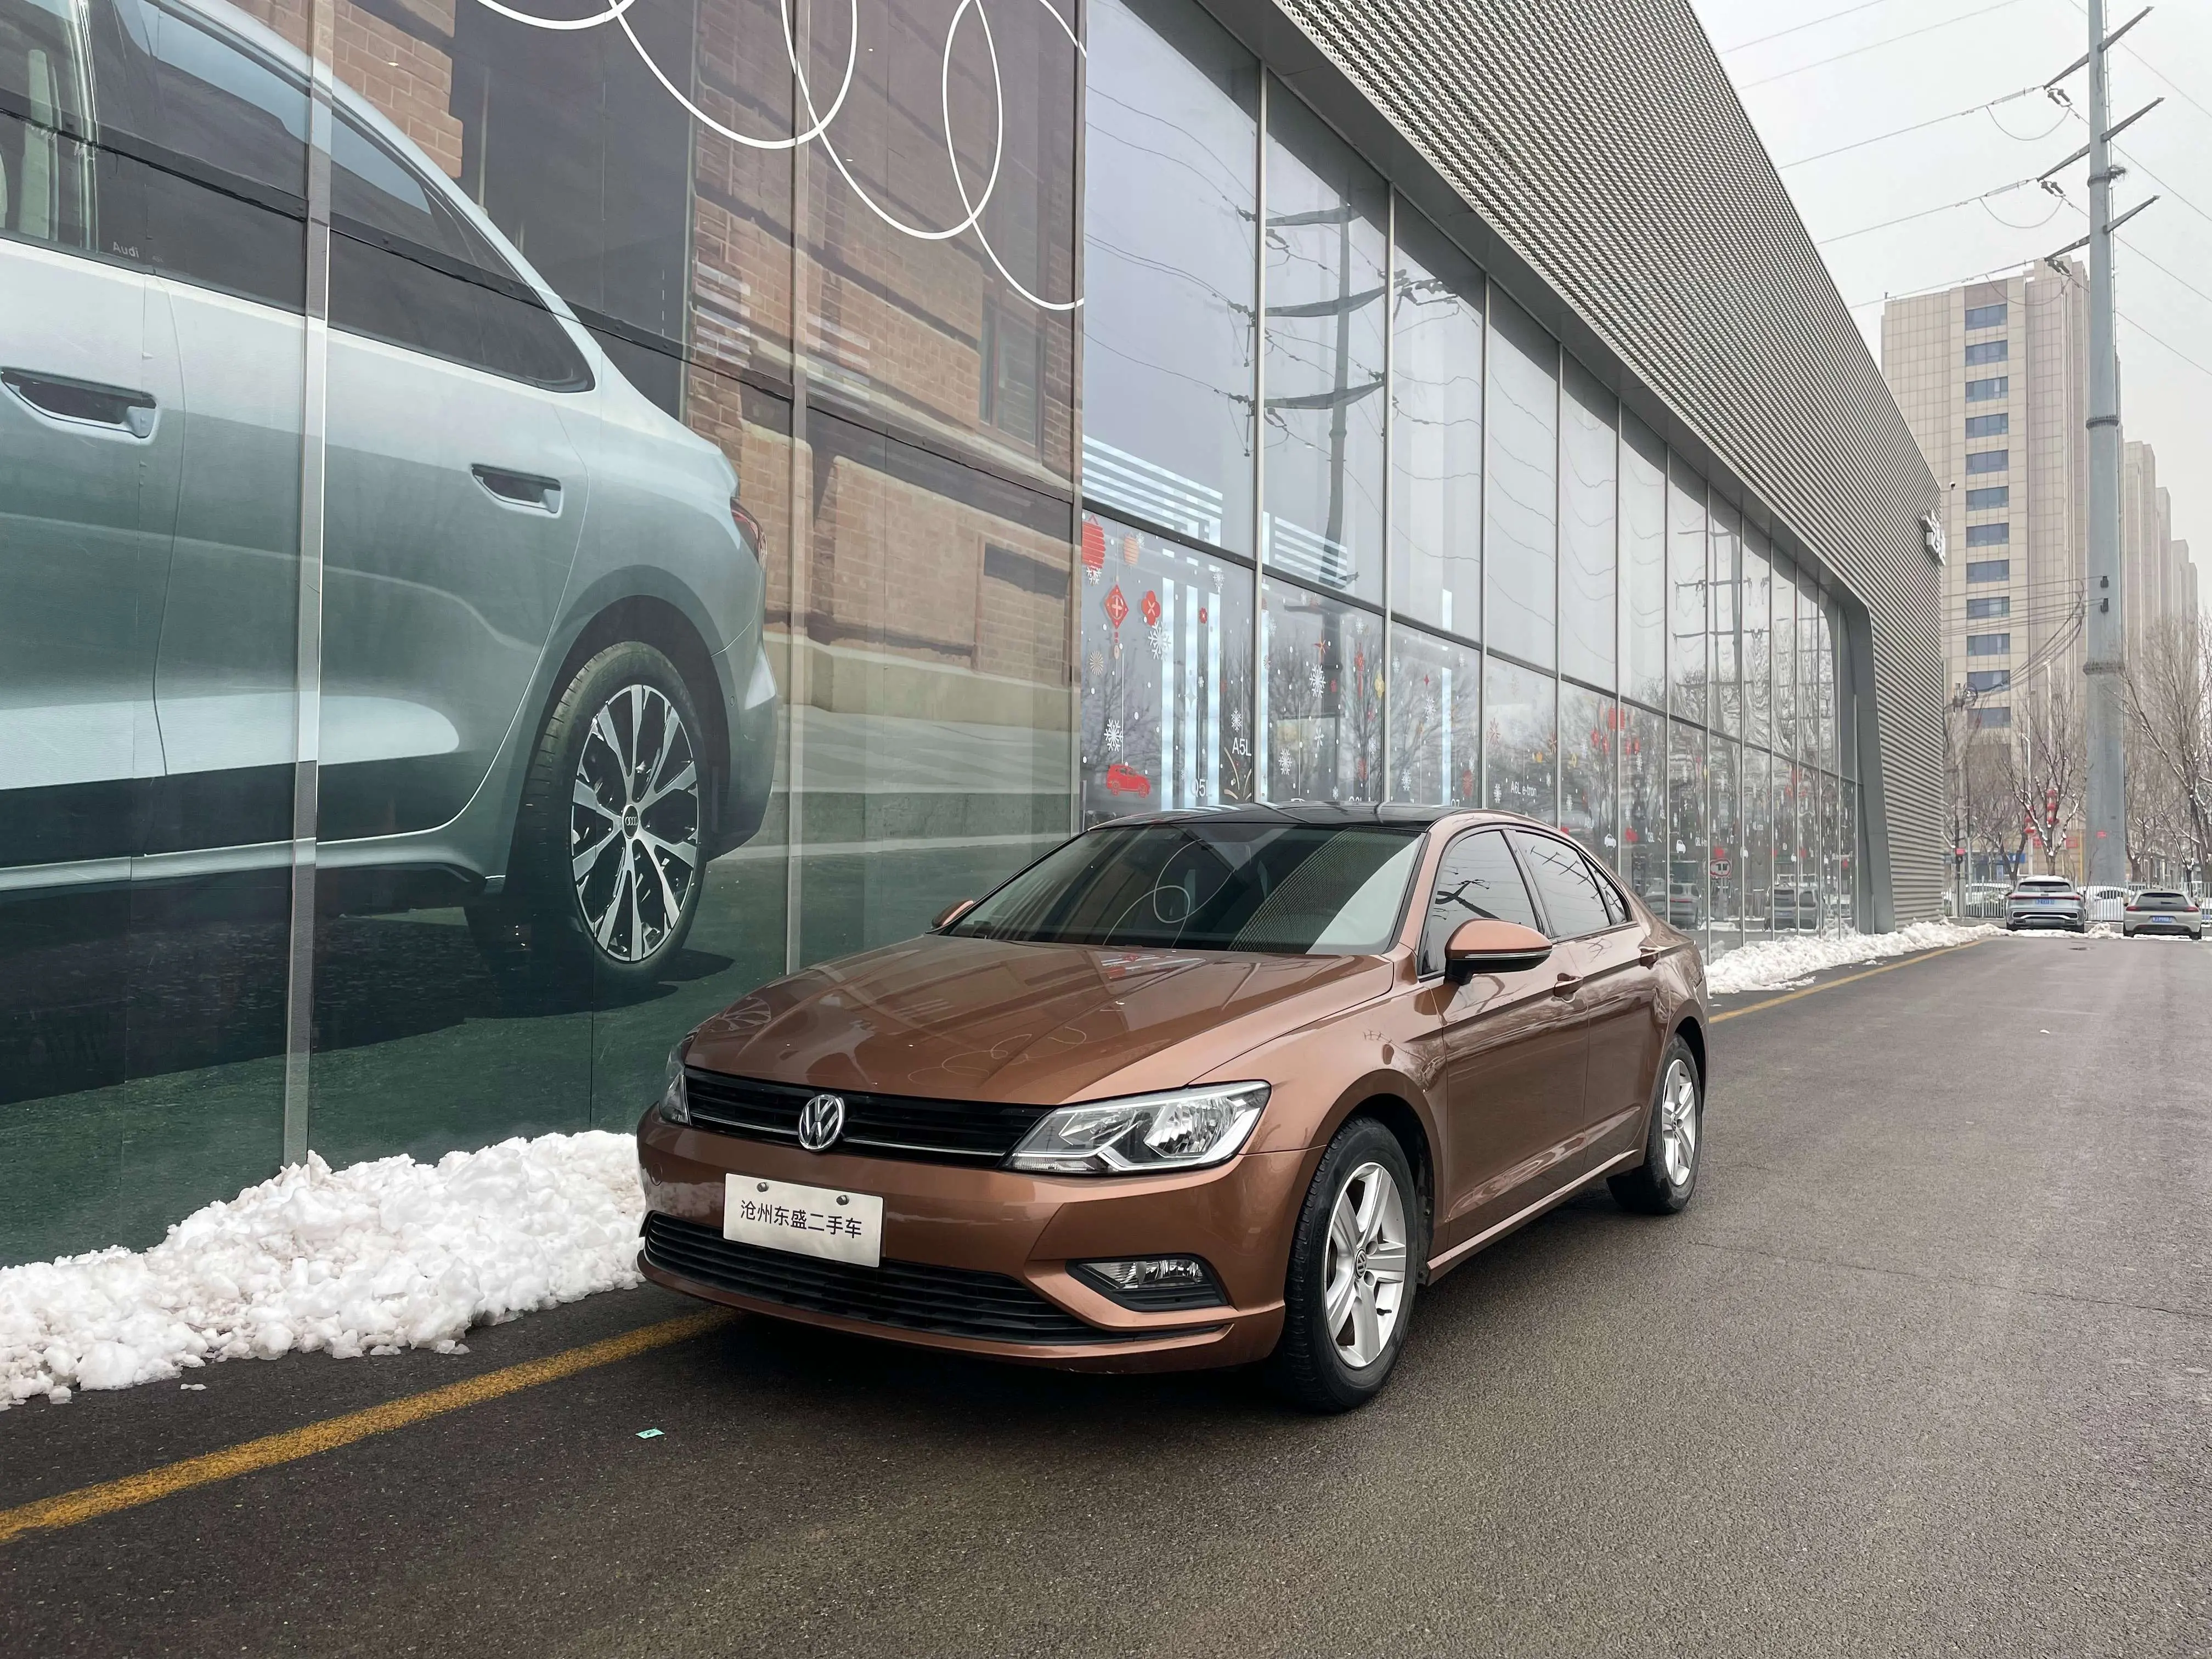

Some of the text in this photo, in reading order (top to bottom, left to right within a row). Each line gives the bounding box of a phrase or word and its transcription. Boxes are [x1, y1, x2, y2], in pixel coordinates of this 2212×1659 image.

[113, 241, 139, 258] Audi
[1232, 737, 1252, 757] A5L
[1190, 778, 1212, 798] Q5L
[1511, 781, 1537, 797] A6L e-tron
[740, 1199, 862, 1239] 沧州东盛二手车
